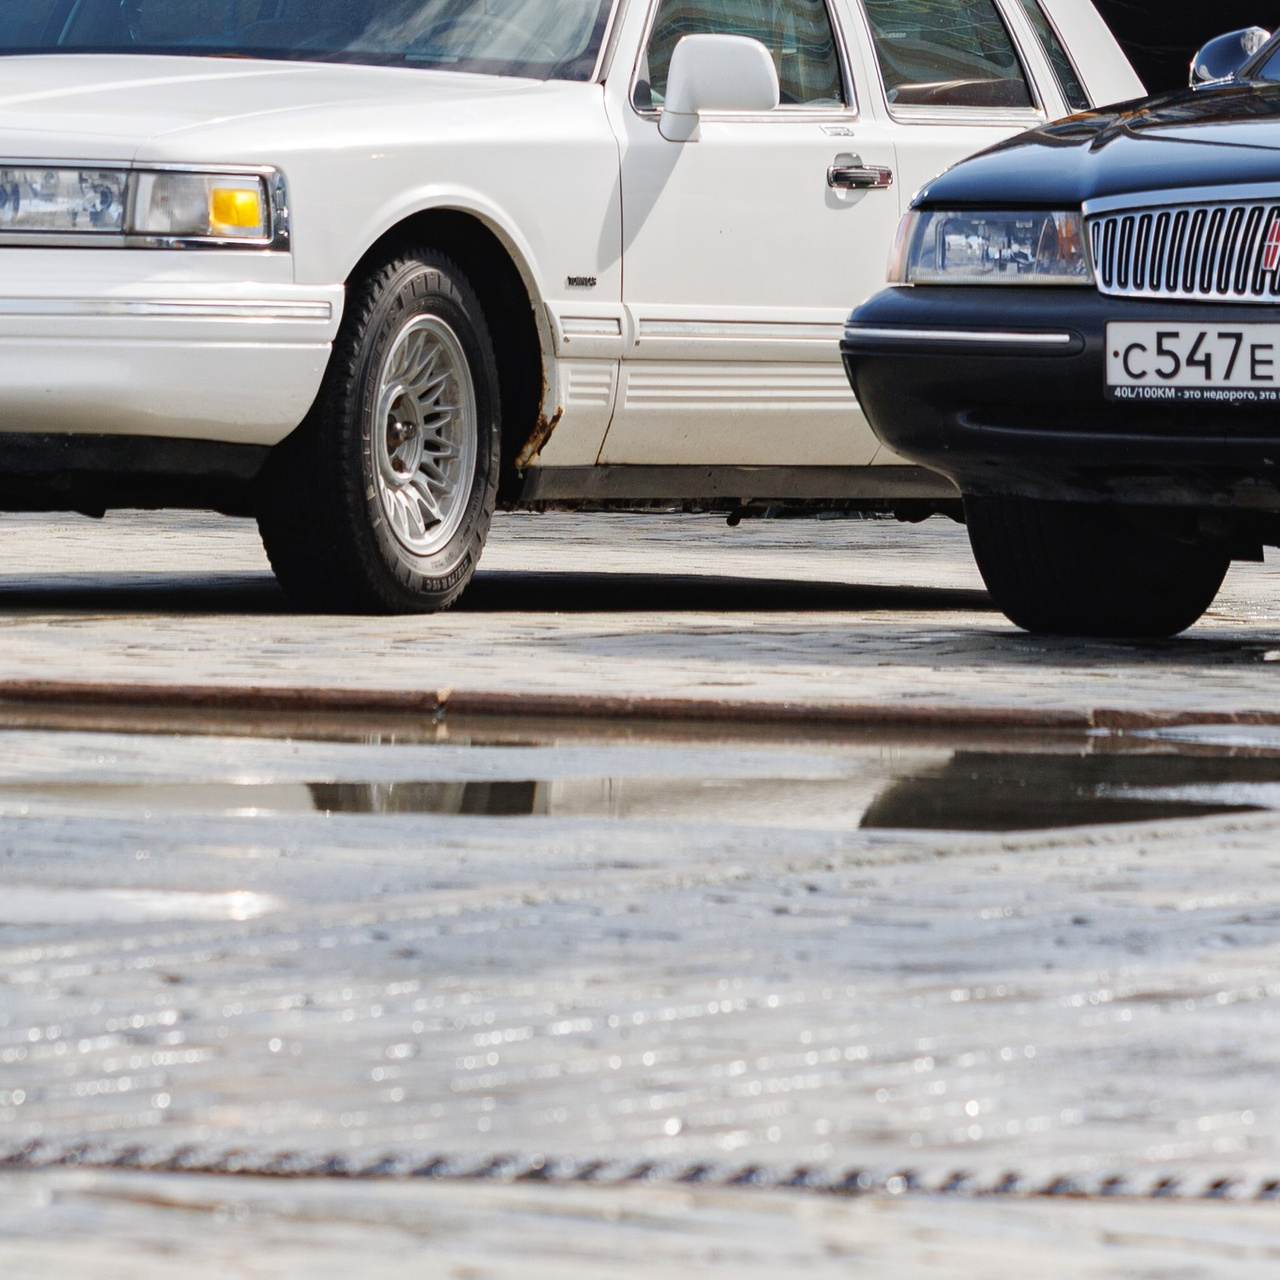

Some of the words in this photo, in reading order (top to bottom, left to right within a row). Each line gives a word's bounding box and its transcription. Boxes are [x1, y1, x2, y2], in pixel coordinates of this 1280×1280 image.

[1183, 390, 1202, 399] это
[1204, 390, 1258, 402] недорого,
[1259, 391, 1277, 400] эта
